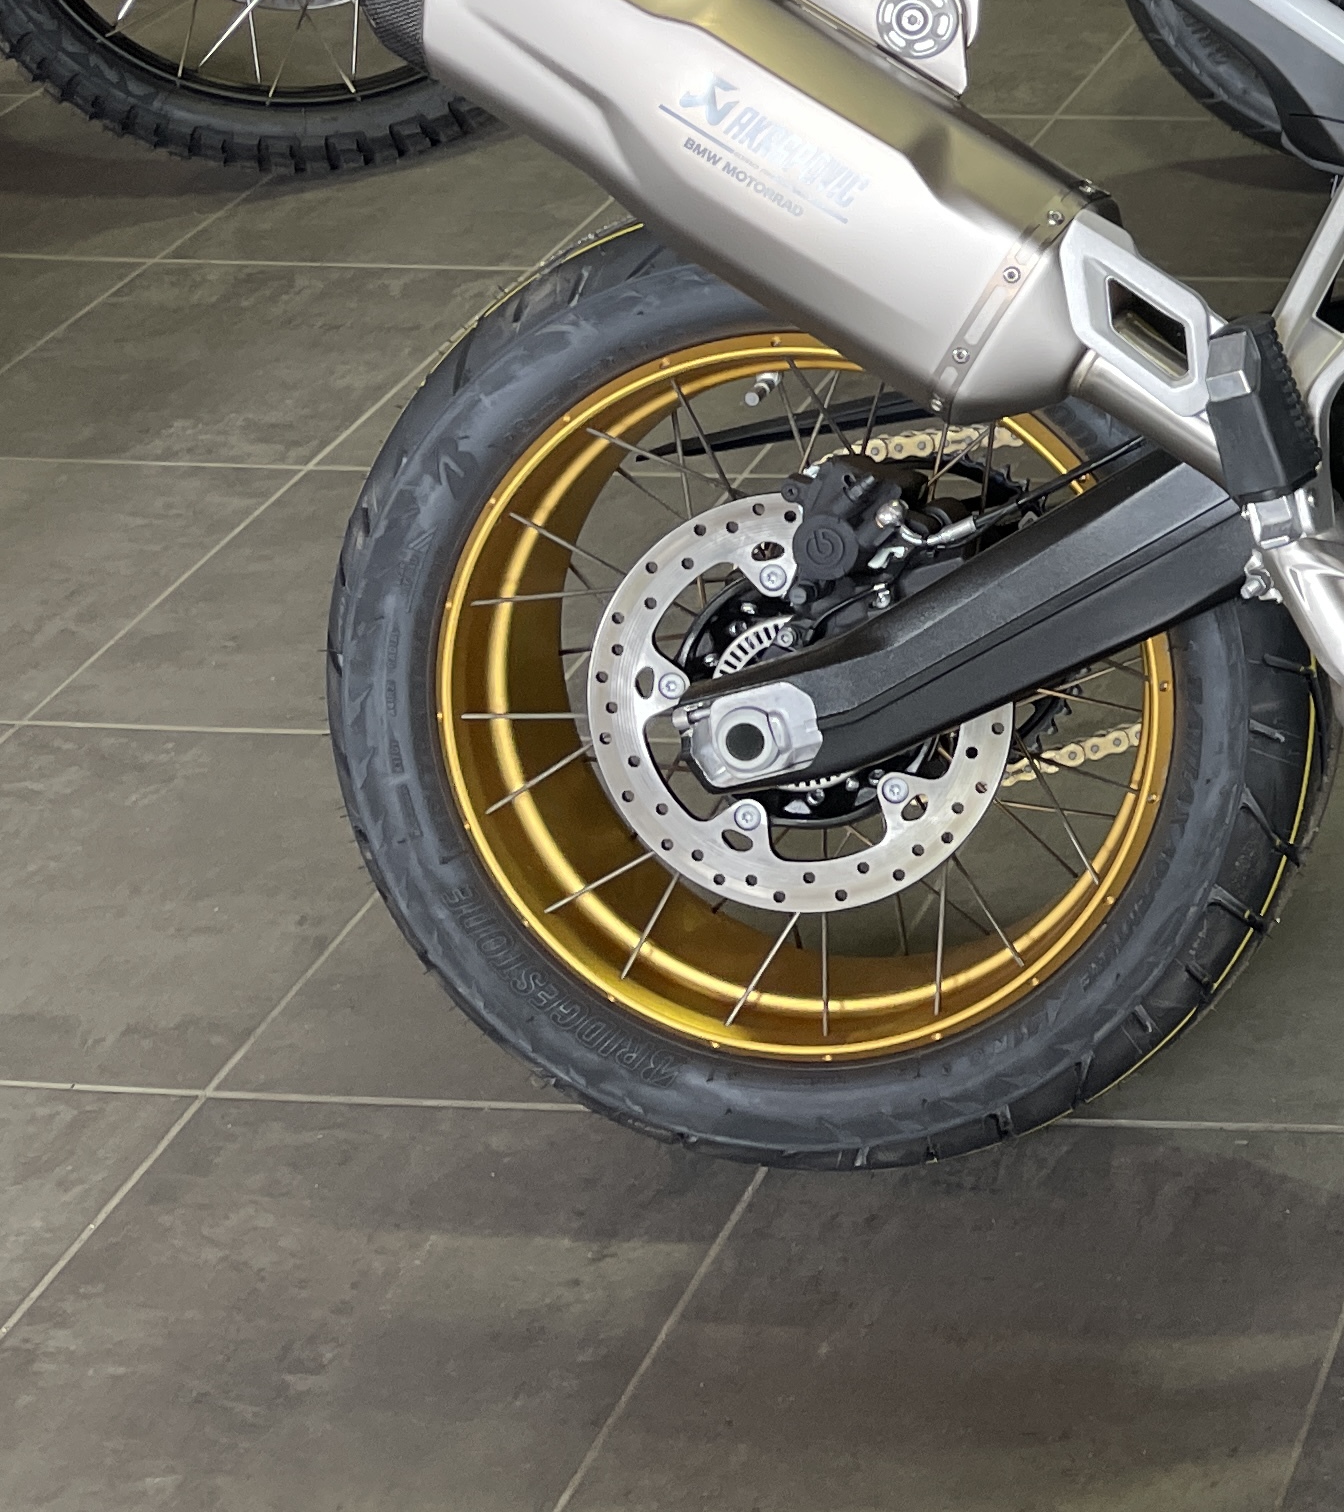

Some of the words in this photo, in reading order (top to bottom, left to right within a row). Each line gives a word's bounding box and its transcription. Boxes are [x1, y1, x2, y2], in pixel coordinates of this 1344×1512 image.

[682, 136, 723, 167] BMW
[721, 159, 805, 219] MOTORRAD
[440, 884, 680, 1089] BRIDGESTONE
